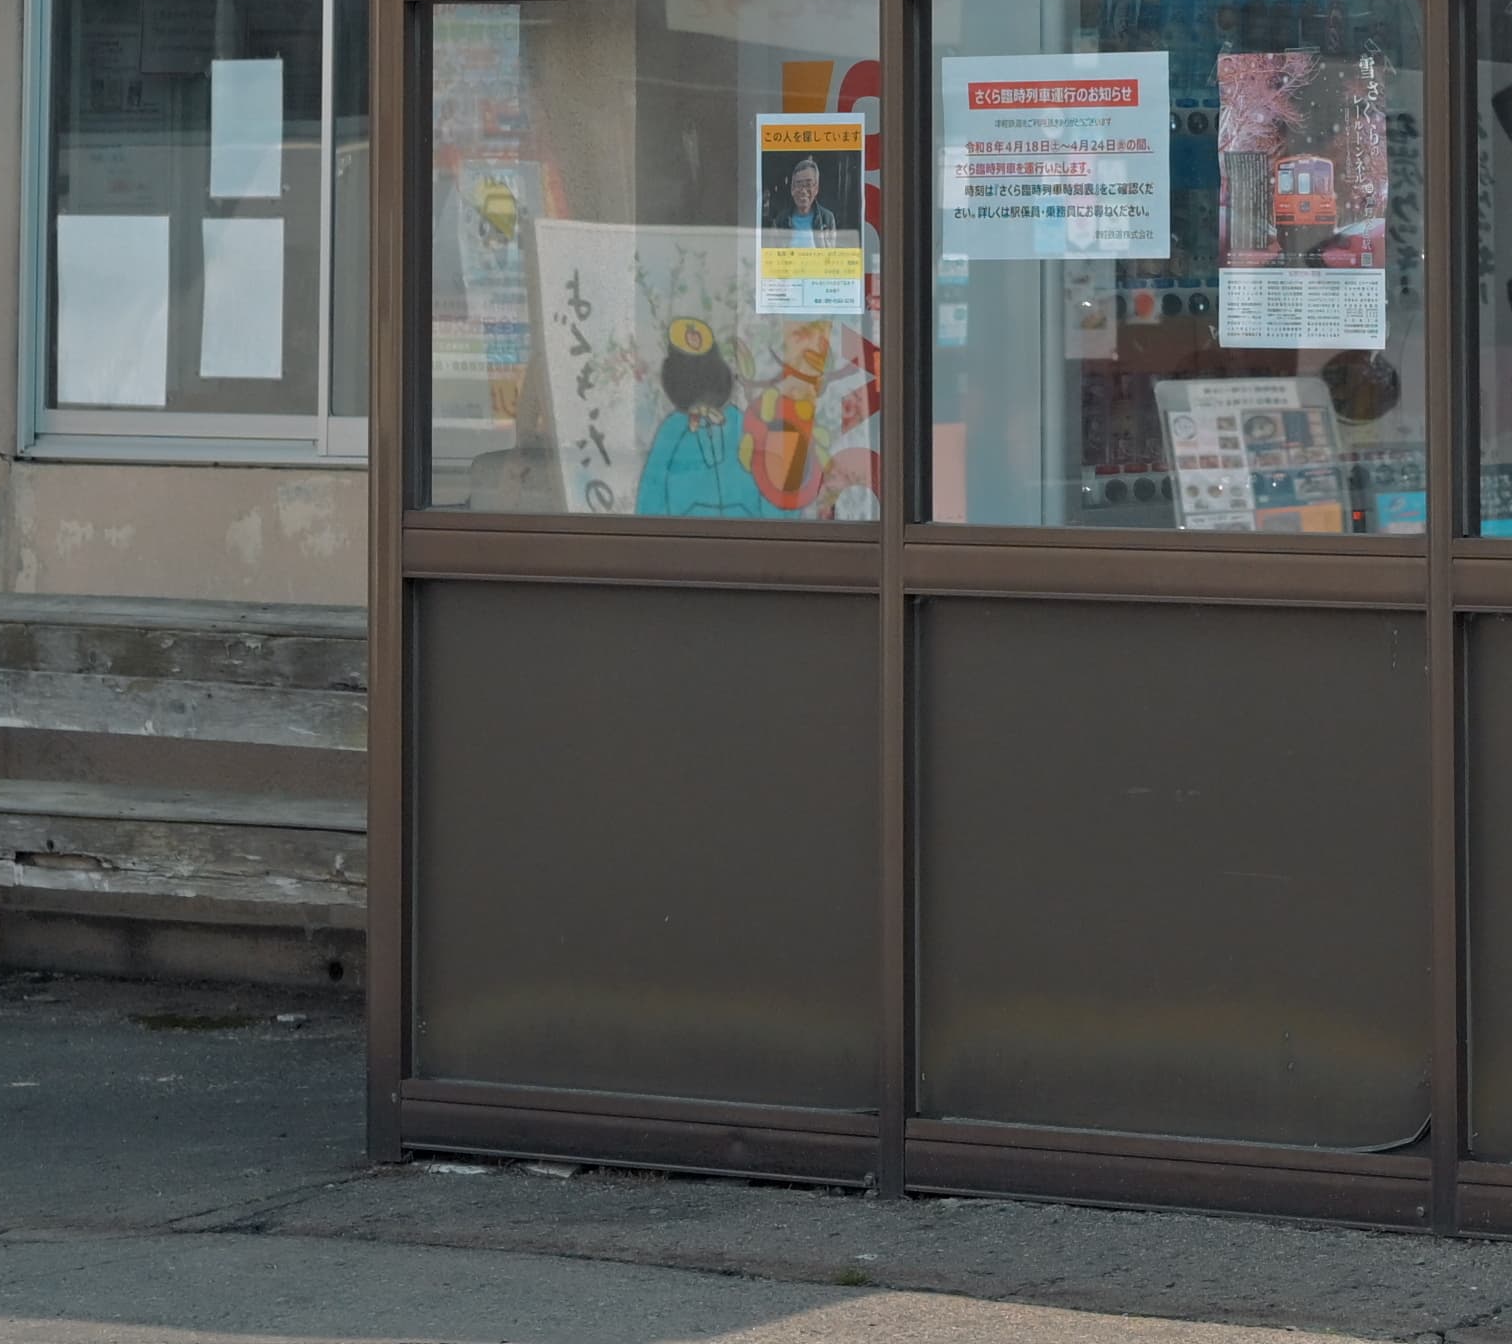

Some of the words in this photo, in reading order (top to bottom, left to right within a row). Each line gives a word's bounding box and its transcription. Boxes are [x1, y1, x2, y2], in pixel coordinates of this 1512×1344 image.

[975, 87, 1132, 105] さくら臨時列車運行のお知らせ
[764, 130, 860, 144] この人を探しています
[955, 162, 1092, 175] さくら臨時列車を運行いたします。
